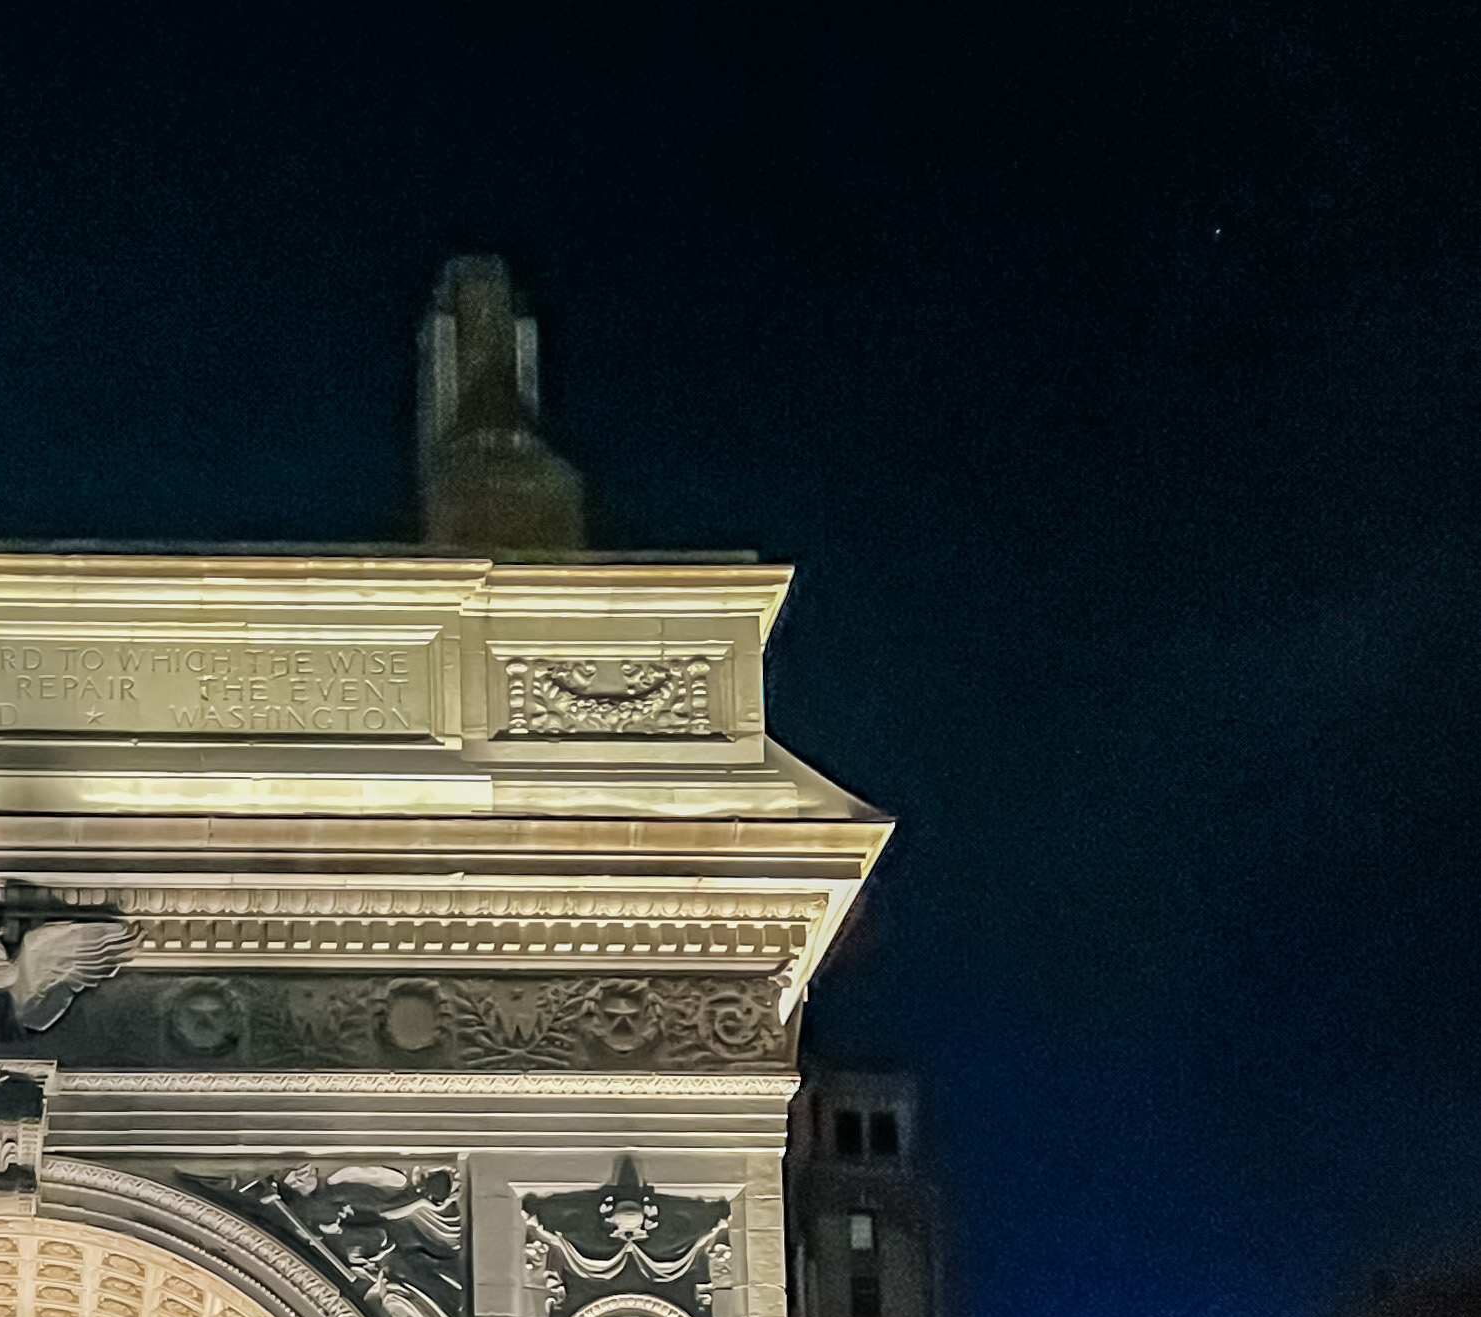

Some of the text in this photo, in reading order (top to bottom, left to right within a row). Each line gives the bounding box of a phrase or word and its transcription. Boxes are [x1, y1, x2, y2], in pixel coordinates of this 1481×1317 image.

[56, 647, 104, 672] TO
[117, 648, 231, 674] WHICH
[244, 649, 313, 675] THE
[326, 650, 409, 675] WISE
[17, 674, 138, 700] REPAIR
[196, 675, 269, 701] THE
[289, 677, 409, 703] EVENT
[169, 704, 411, 731] WASHINGTON
